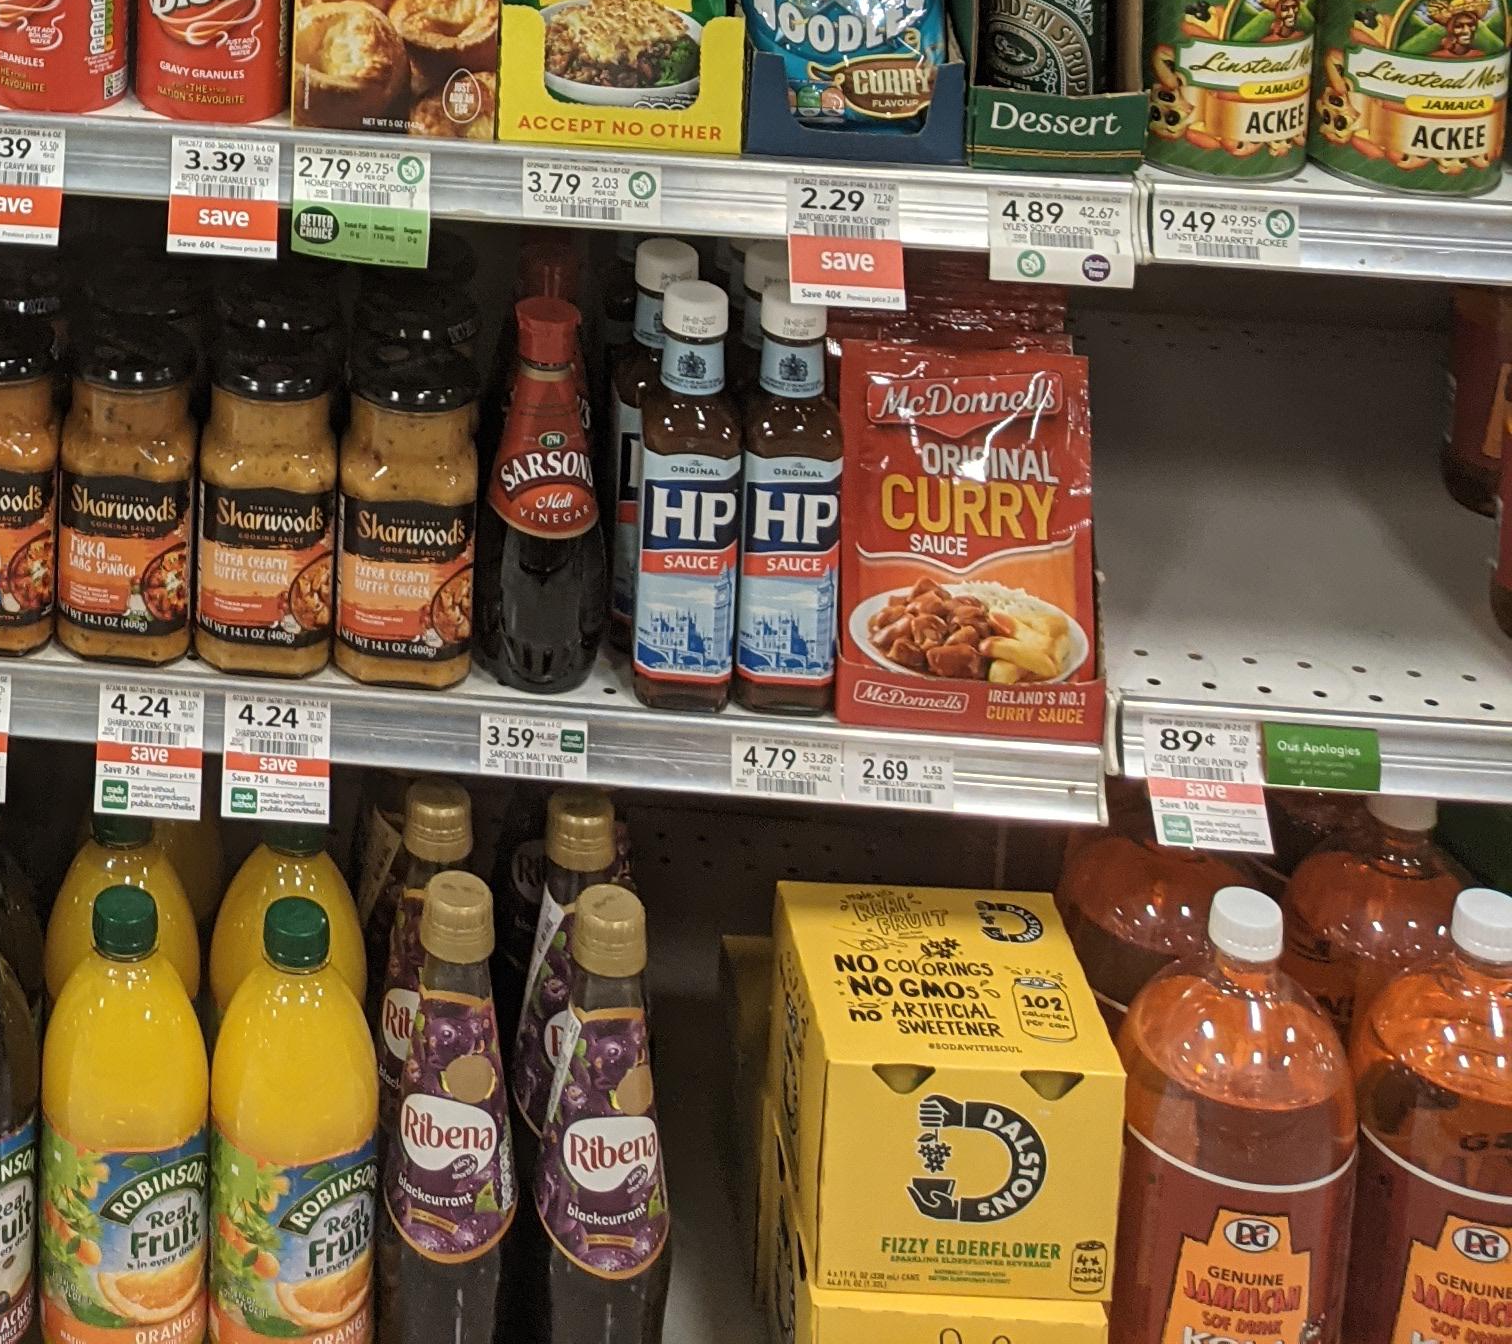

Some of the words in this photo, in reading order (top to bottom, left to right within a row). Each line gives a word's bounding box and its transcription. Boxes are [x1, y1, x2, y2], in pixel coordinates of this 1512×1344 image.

[518, 116, 603, 137] ACCEPT
[611, 121, 642, 138] NO
[650, 123, 722, 140] OTHER
[990, 101, 1121, 135] Dessert
[1160, 208, 1215, 232] 9.49
[650, 487, 736, 542] HP
[881, 475, 1056, 541] CURRY
[664, 554, 718, 570] SAUCE
[988, 690, 1056, 704] IRELAND'S
[1059, 691, 1085, 705] NO.1
[742, 746, 796, 769] 4.79
[1303, 743, 1360, 759] Apologies
[835, 954, 879, 977] NO
[884, 957, 993, 978] COLORINGS
[402, 1112, 494, 1151] Ribena
[398, 1176, 473, 1207] blackcurrant
[881, 1236, 930, 1256] FIZZY
[936, 1237, 1061, 1260] ELDERFLOWER
